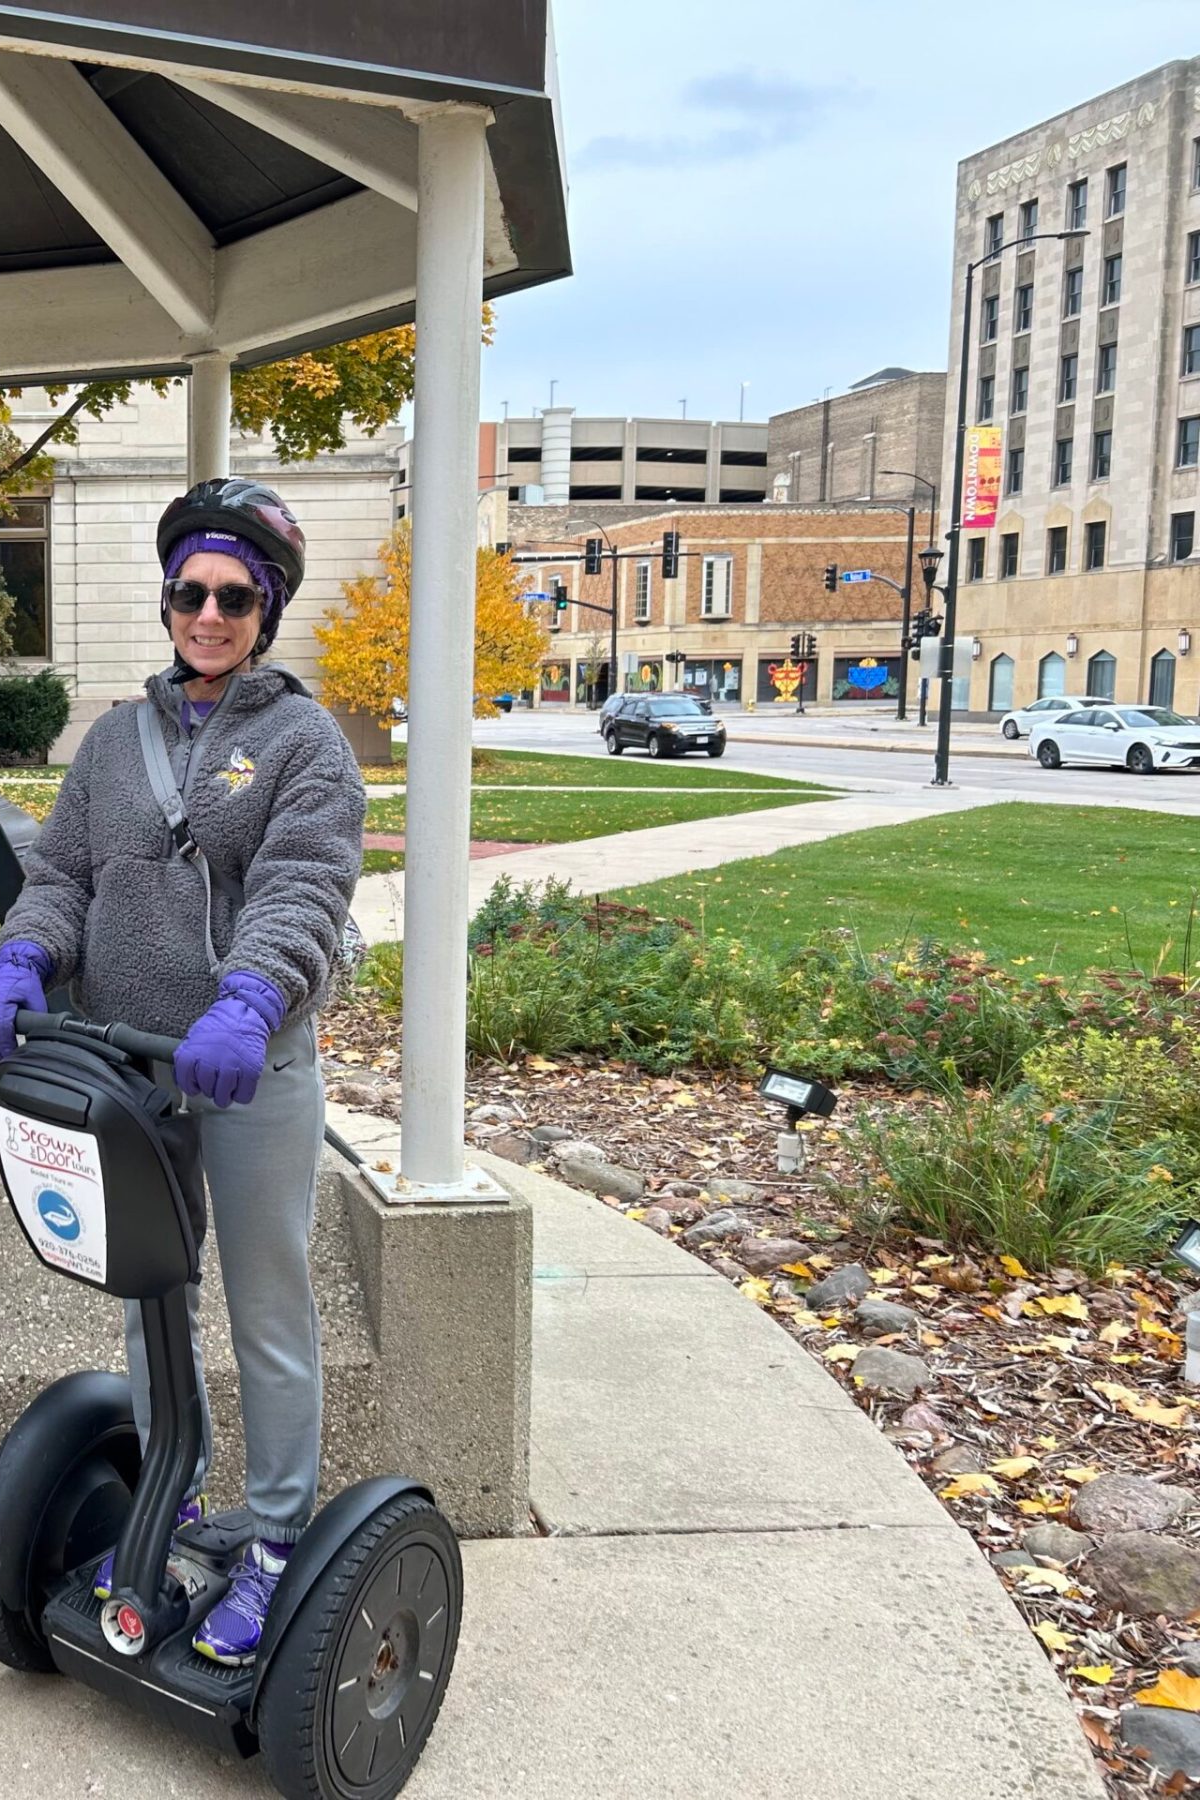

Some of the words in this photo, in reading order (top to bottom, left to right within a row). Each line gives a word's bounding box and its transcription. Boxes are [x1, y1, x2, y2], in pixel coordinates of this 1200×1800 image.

[964, 433, 980, 521] DOWNTOWN
[36, 1145, 71, 1167] Door
[72, 1161, 96, 1176] tours
